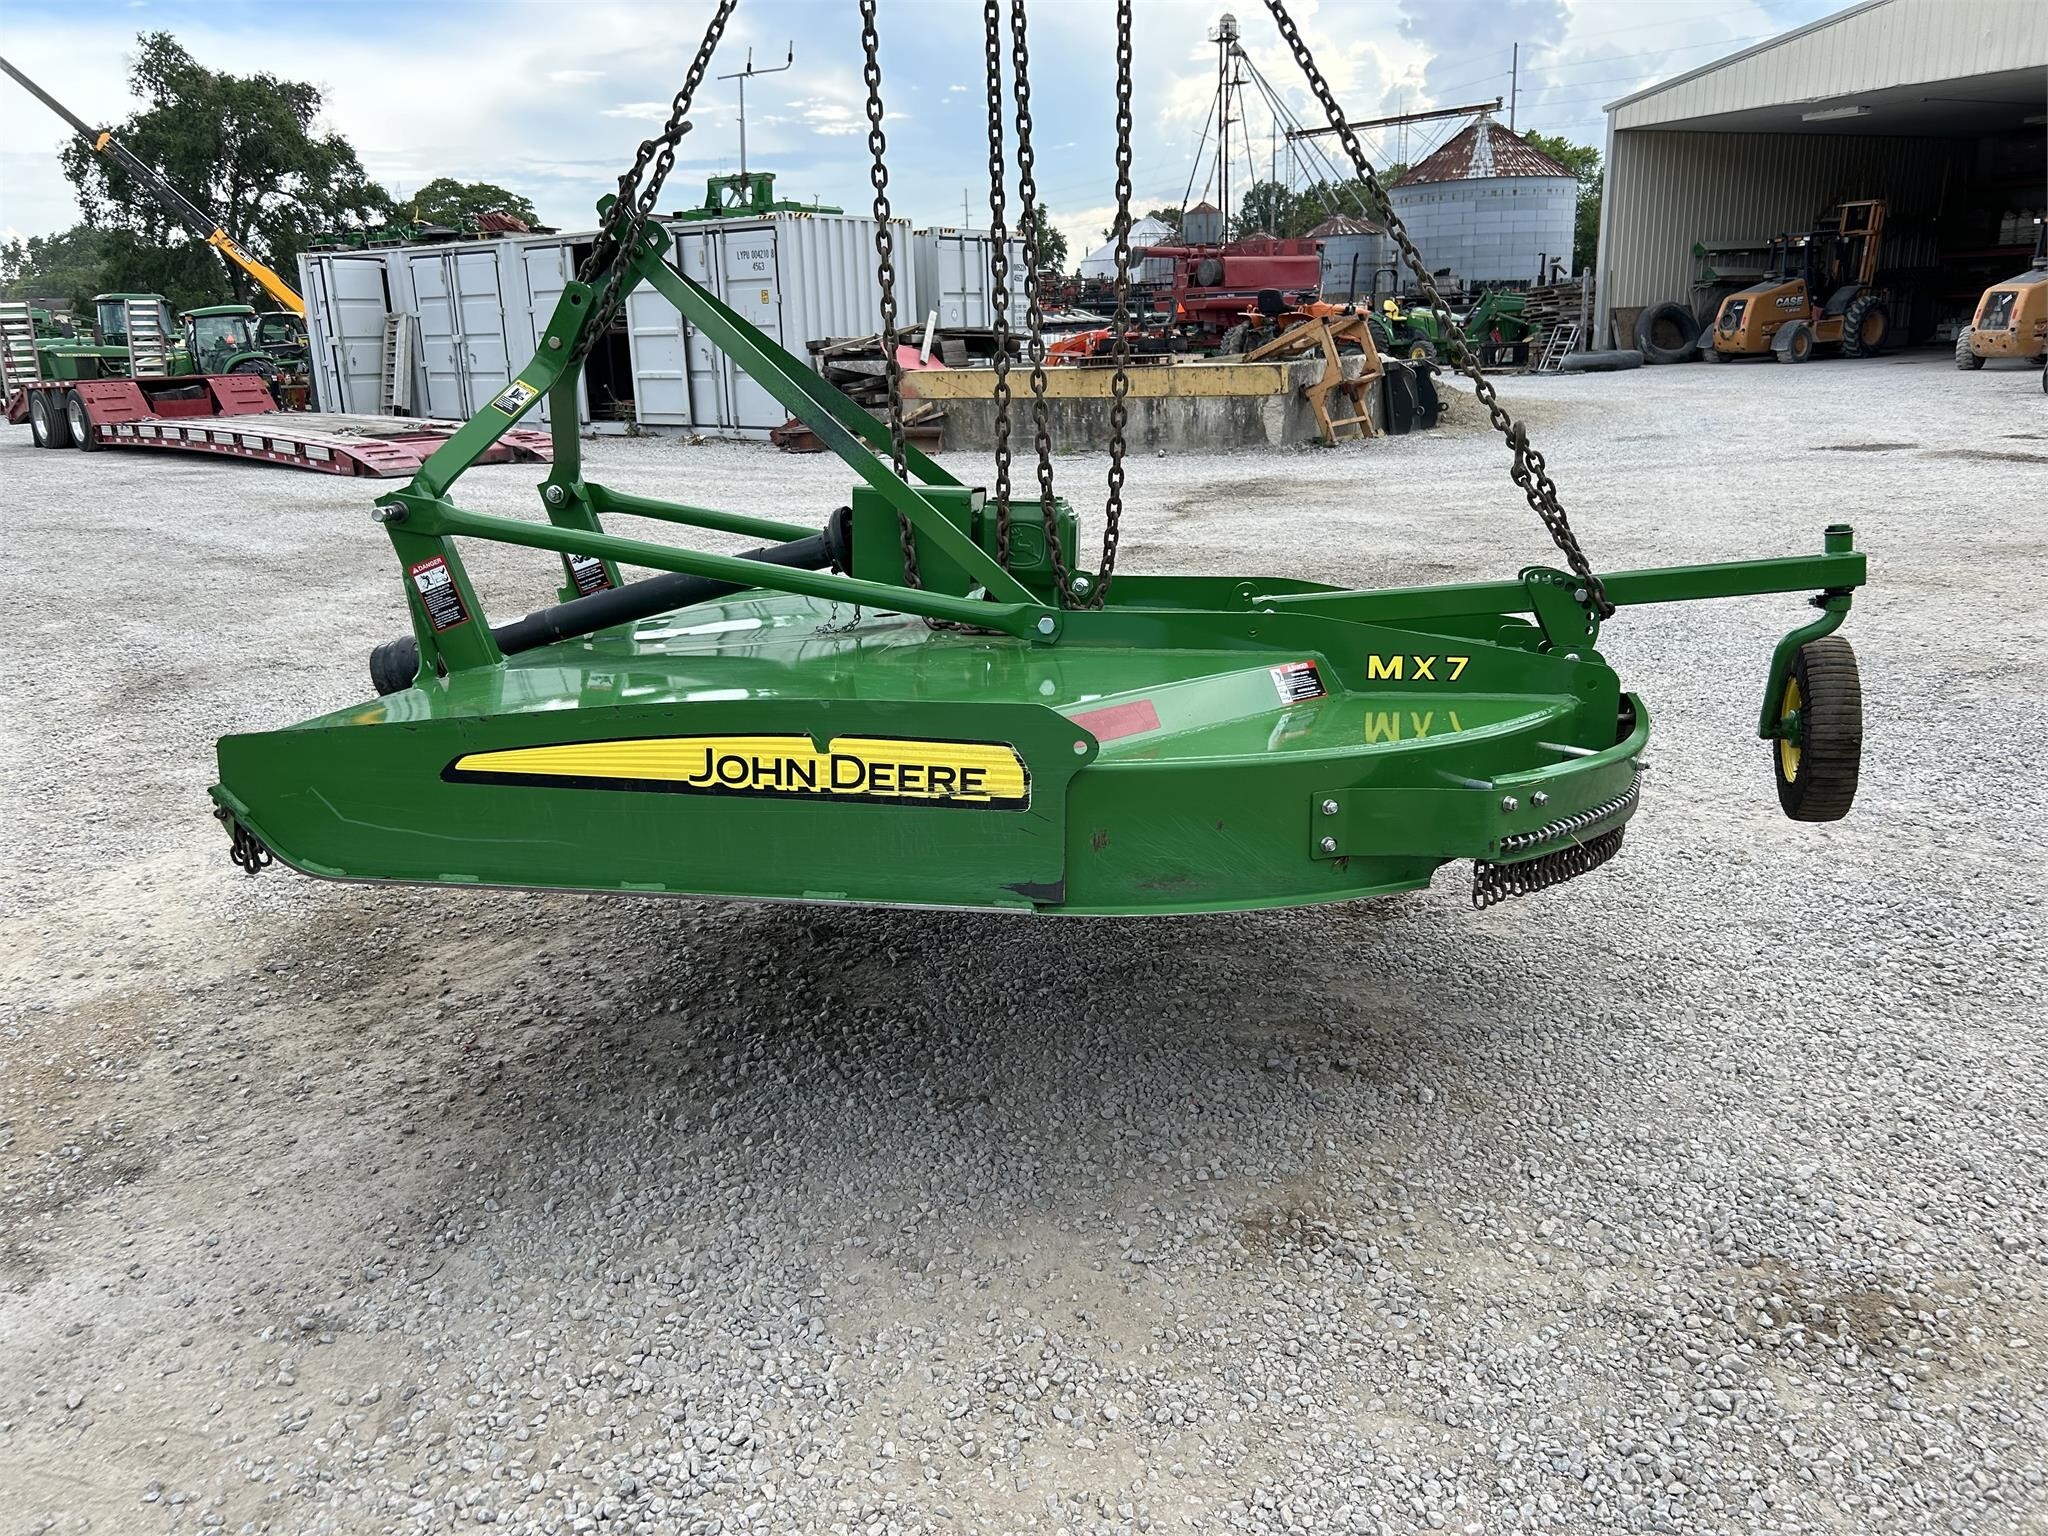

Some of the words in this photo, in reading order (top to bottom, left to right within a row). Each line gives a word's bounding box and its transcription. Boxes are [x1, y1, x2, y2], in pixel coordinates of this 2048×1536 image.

[1776, 296, 1804, 308] CASE
[417, 557, 442, 571] DANGER
[690, 748, 816, 788] JOHN
[831, 754, 988, 796] DEERE
